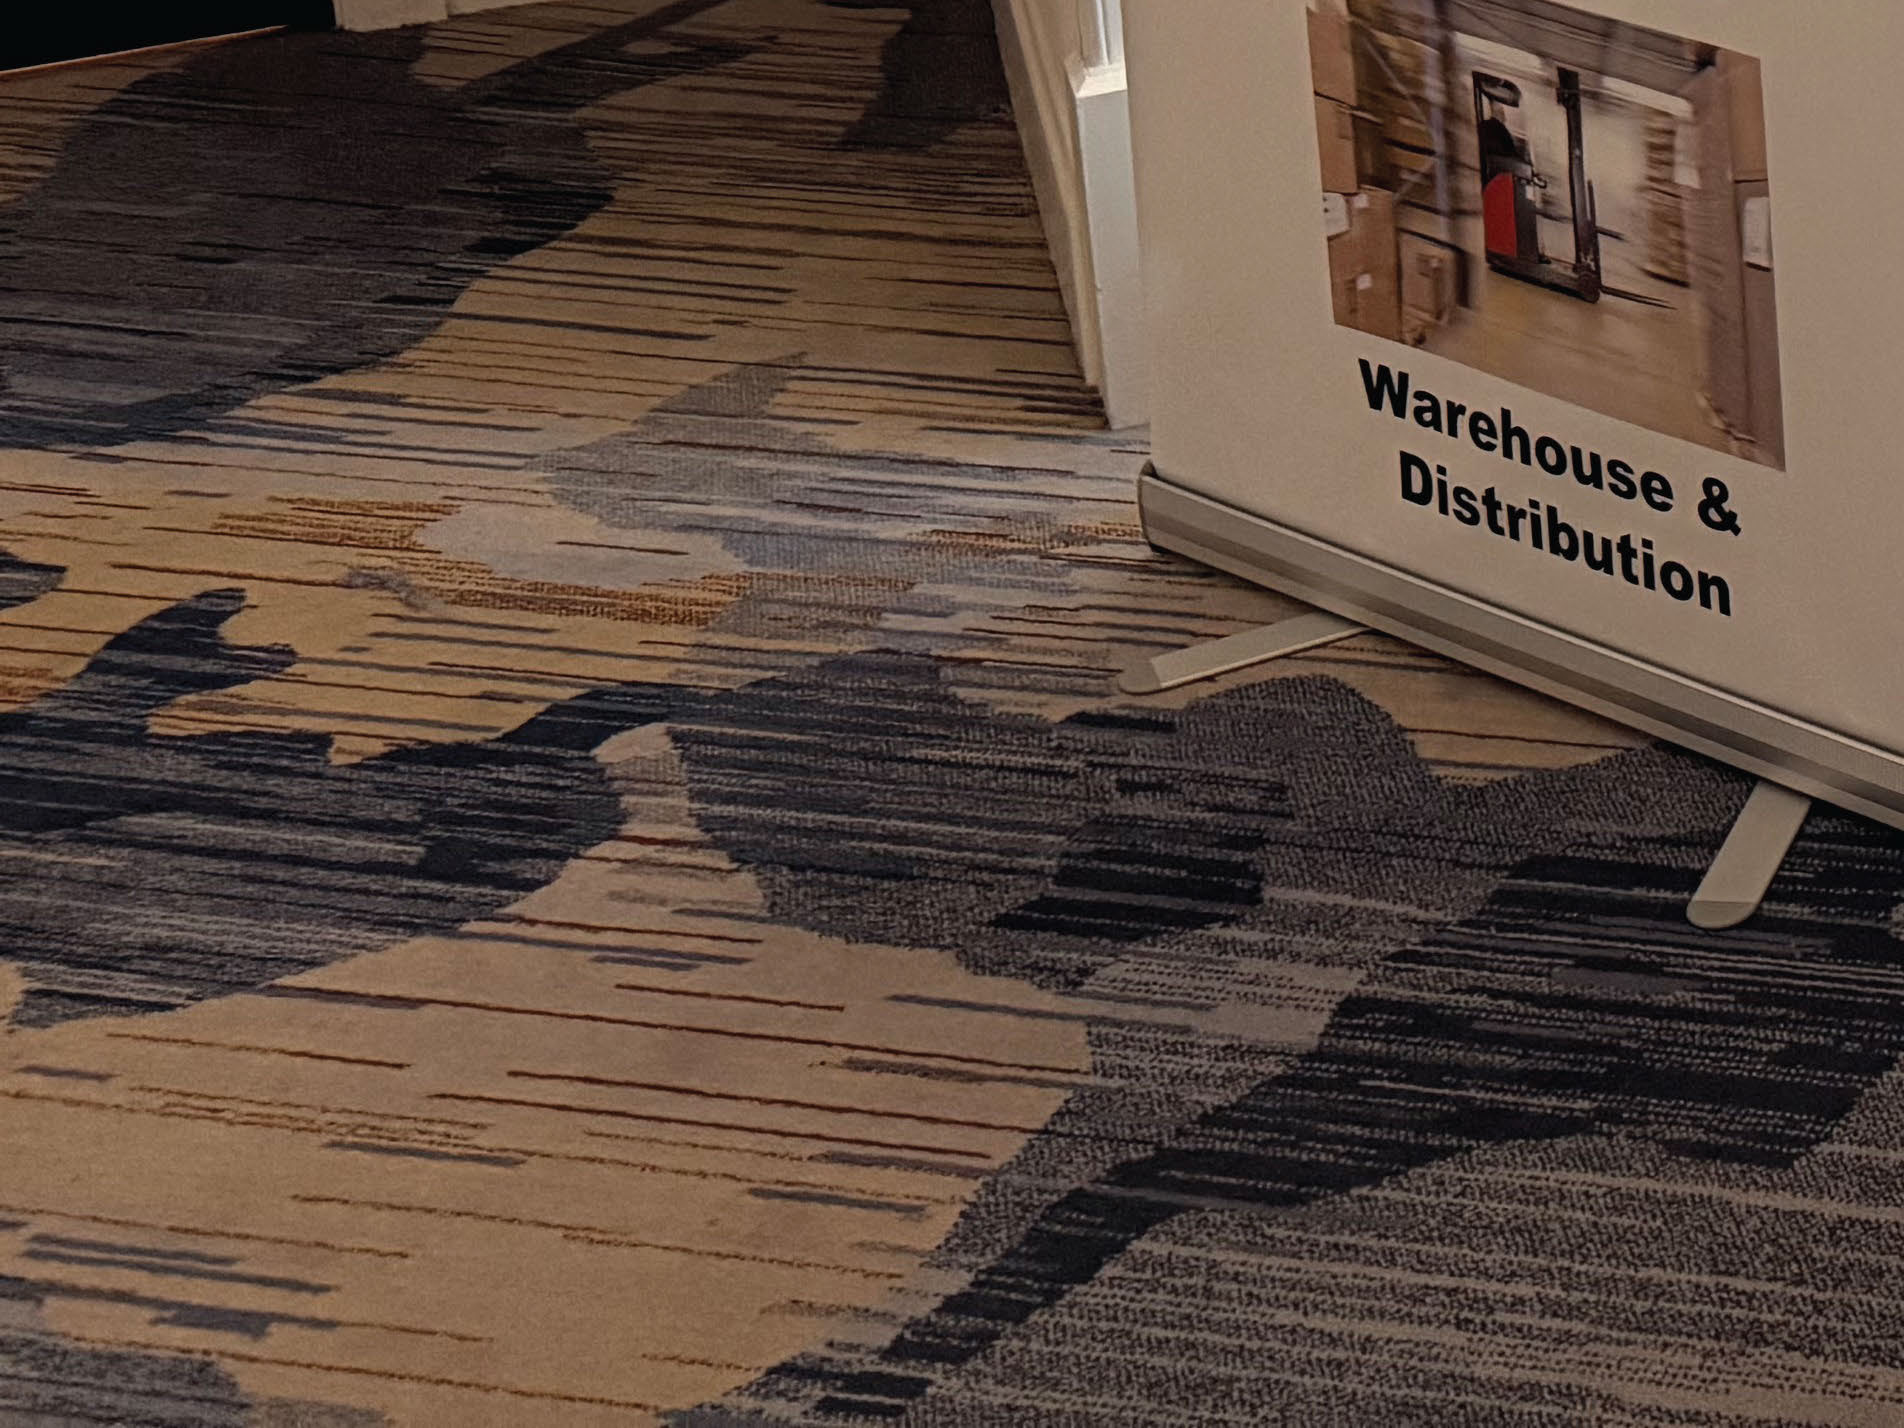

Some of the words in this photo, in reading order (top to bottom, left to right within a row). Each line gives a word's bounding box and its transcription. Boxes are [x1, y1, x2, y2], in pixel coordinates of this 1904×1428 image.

[1357, 357, 1674, 512] Warehouse
[1698, 476, 1742, 537] &
[1399, 449, 1733, 617] Distribution
